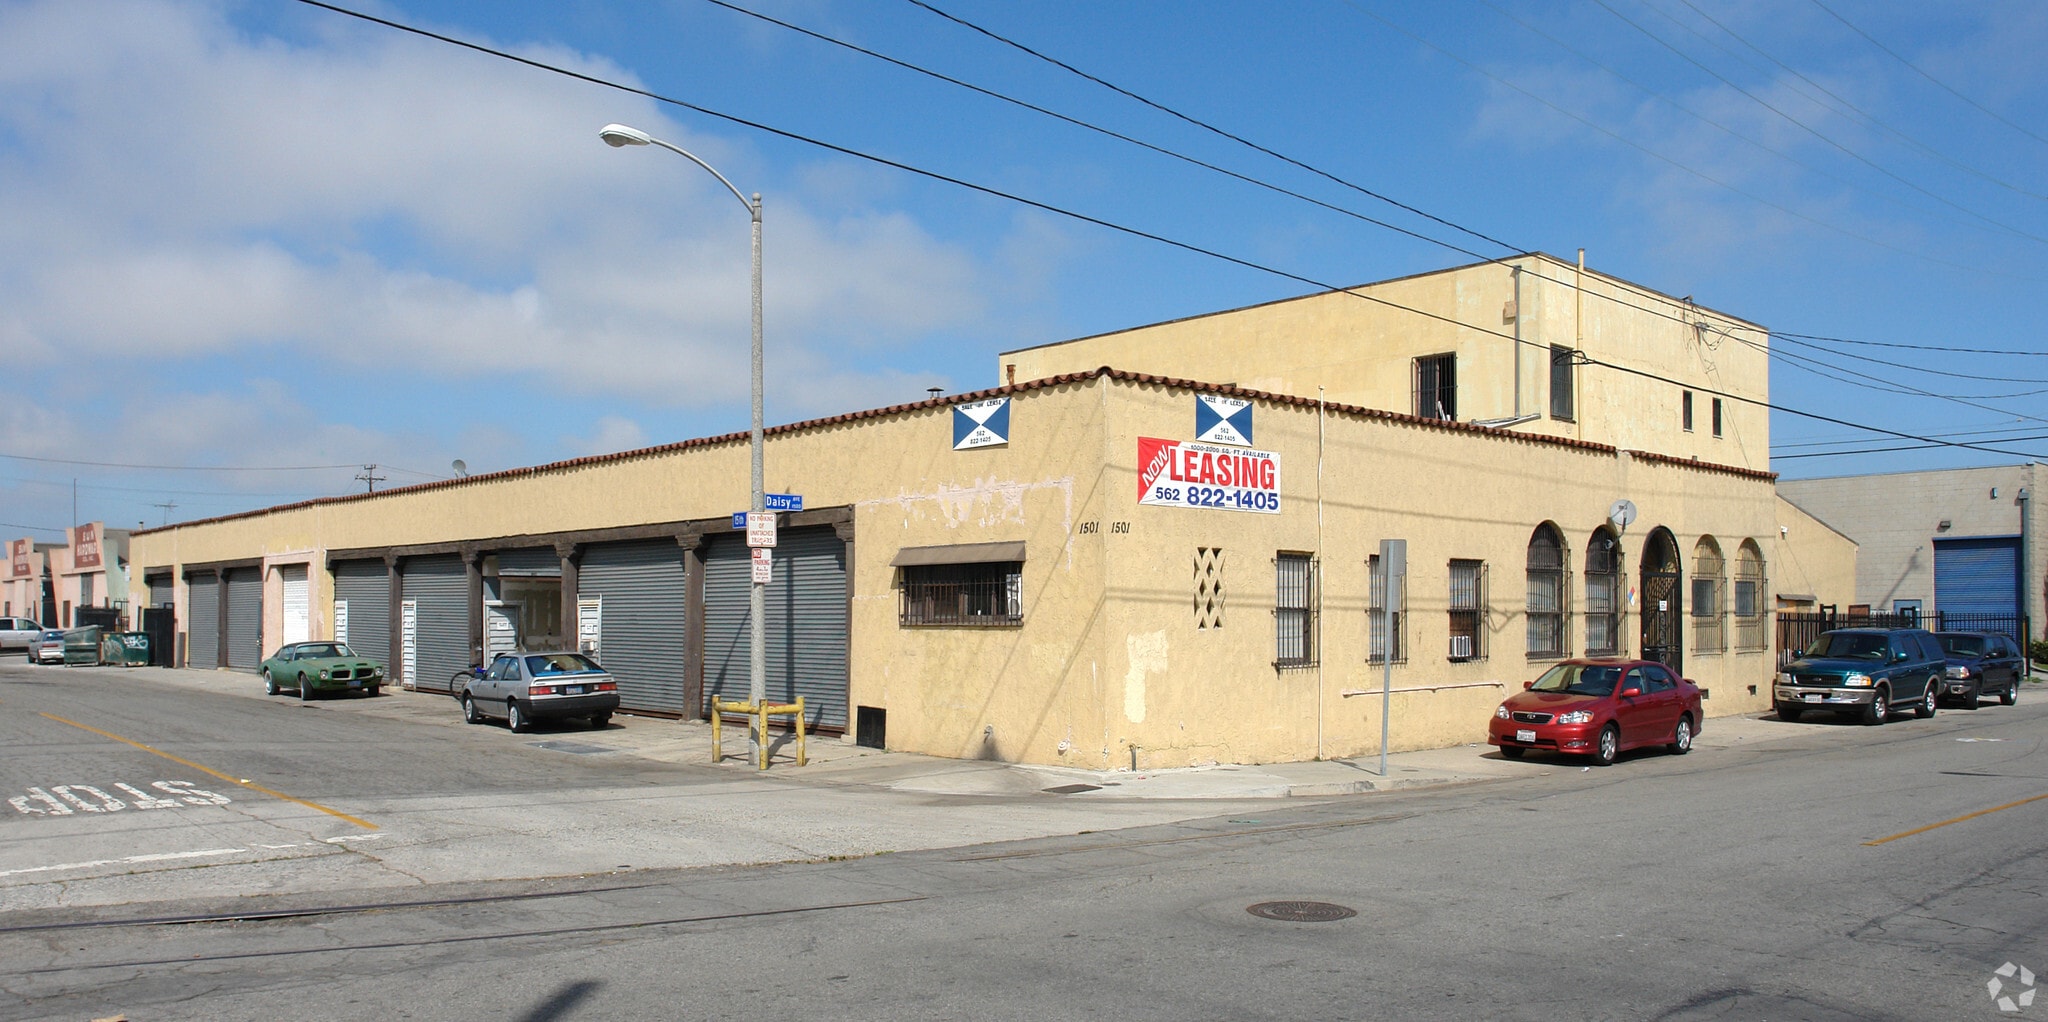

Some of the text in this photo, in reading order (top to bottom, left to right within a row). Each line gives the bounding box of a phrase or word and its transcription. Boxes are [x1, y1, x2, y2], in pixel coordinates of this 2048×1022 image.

[1242, 450, 1270, 459] AVAILABLE
[1141, 444, 1169, 488] NOW
[1169, 448, 1276, 490] LEASING
[766, 496, 791, 509] Daisy
[1155, 486, 1279, 510] 562 822-1405
[1079, 521, 1100, 535] 1501
[1111, 521, 1131, 534] 1501
[8, 780, 232, 816] STOP
